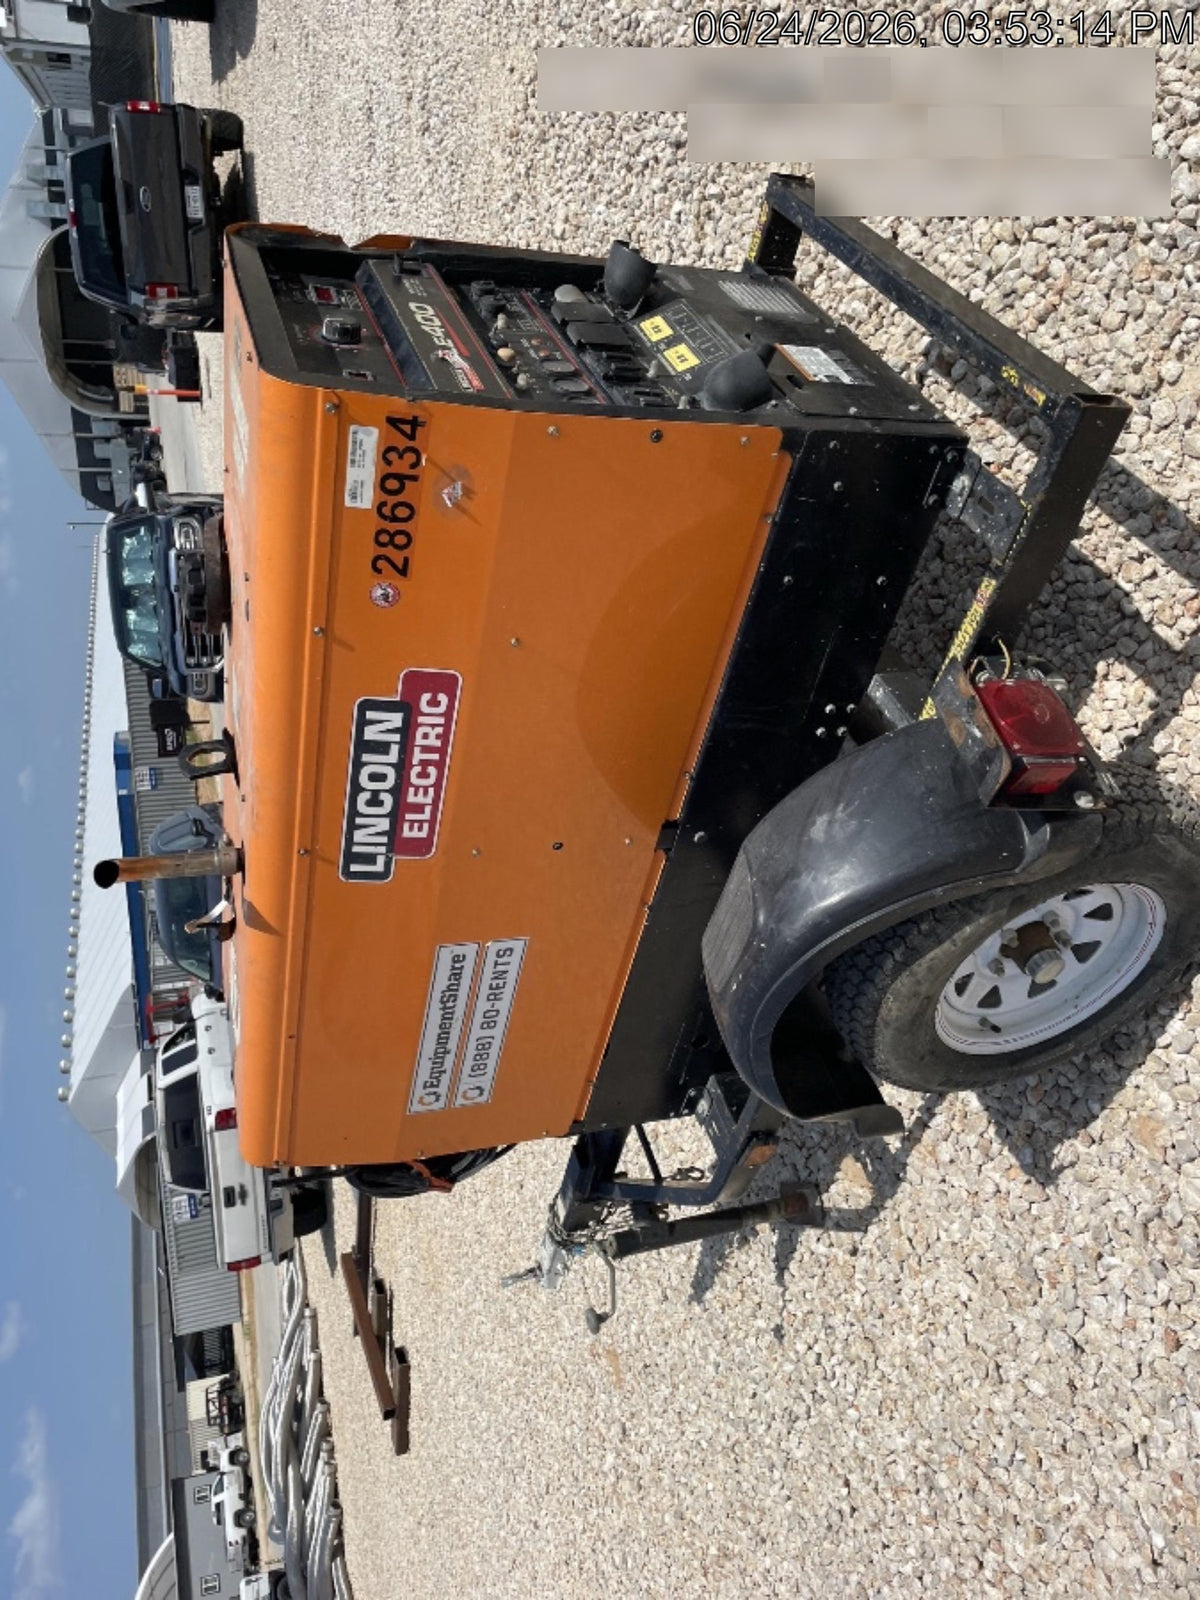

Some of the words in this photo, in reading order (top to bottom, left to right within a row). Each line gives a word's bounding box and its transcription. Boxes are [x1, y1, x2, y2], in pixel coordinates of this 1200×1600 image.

[370, 415, 426, 579] 286934
[349, 710, 404, 873] LINCOLN
[402, 692, 449, 839] ELECTRIC
[423, 952, 467, 1090] EquipmentShare
[469, 1035, 495, 1079] (888)
[481, 946, 514, 1030] 80-RENTS
